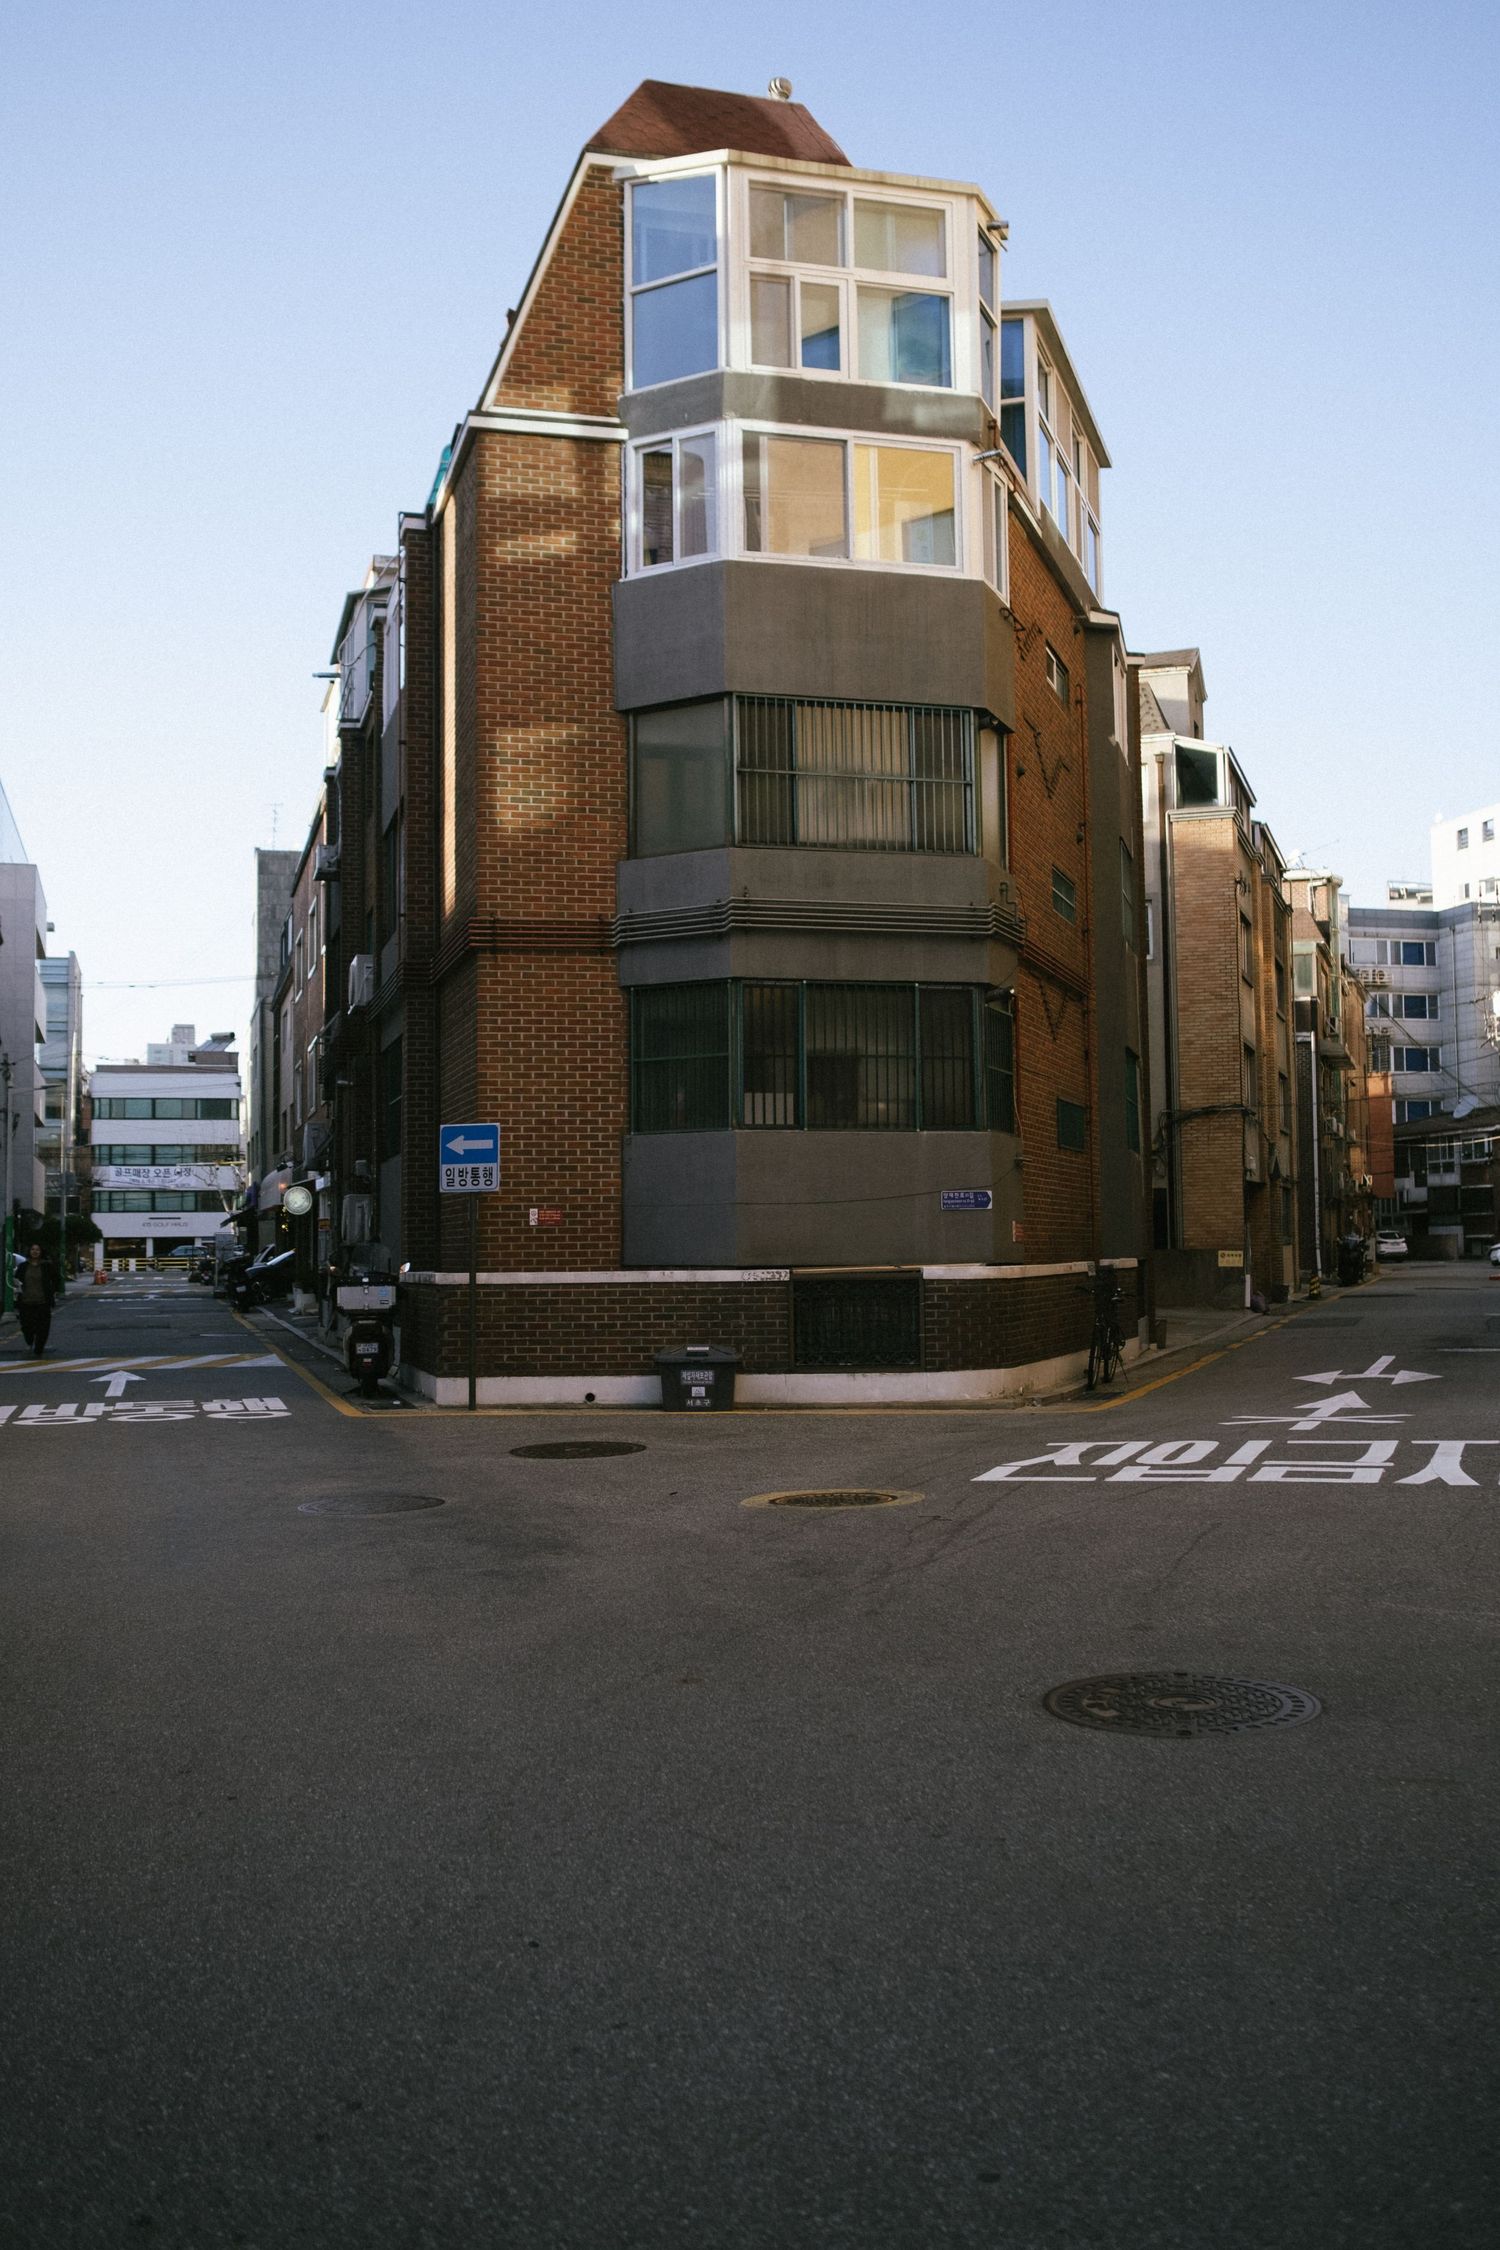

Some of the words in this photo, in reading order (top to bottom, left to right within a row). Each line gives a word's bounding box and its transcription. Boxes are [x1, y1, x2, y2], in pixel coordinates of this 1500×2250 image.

[154, 1168, 171, 1178] 오픈
[445, 1167, 493, 1187] 일방통행
[0, 1397, 292, 1427] 방통행
